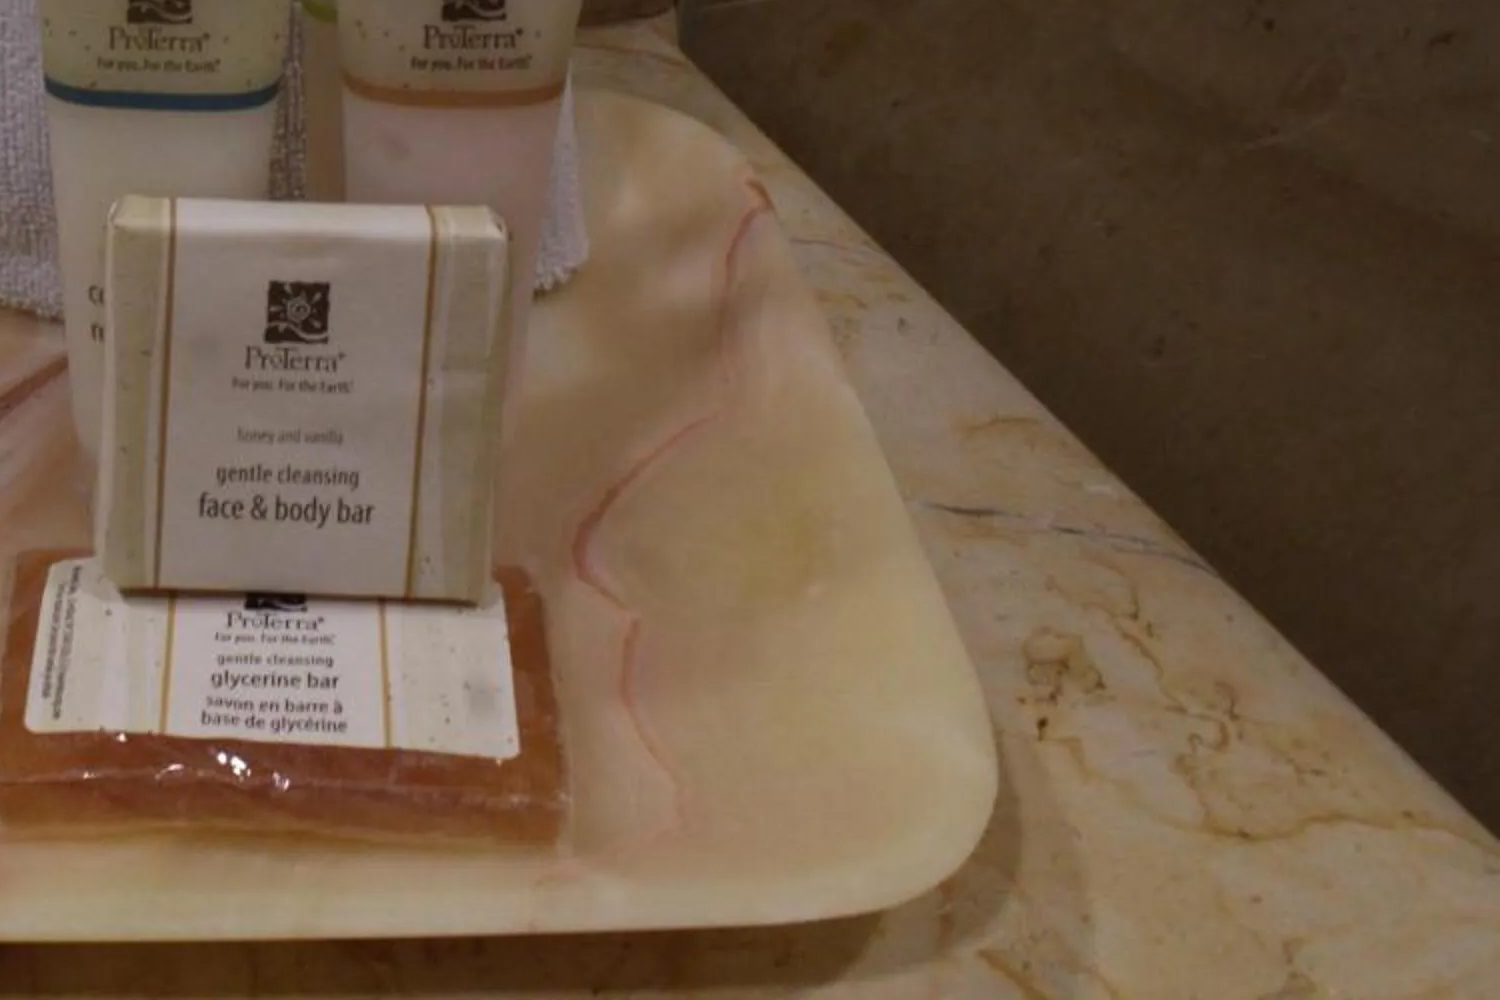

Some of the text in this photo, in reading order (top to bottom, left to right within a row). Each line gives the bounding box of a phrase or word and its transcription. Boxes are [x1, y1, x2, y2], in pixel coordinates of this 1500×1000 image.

[277, 428, 301, 444] and
[215, 463, 360, 491] gentle cleansing
[198, 491, 376, 530] face & body bar
[217, 654, 334, 669] gentle cleansing
[211, 669, 340, 691] glycerine bar
[206, 696, 255, 712] savon
[259, 700, 280, 713] en
[284, 697, 330, 713] barre
[201, 709, 348, 734] base de glycérine
